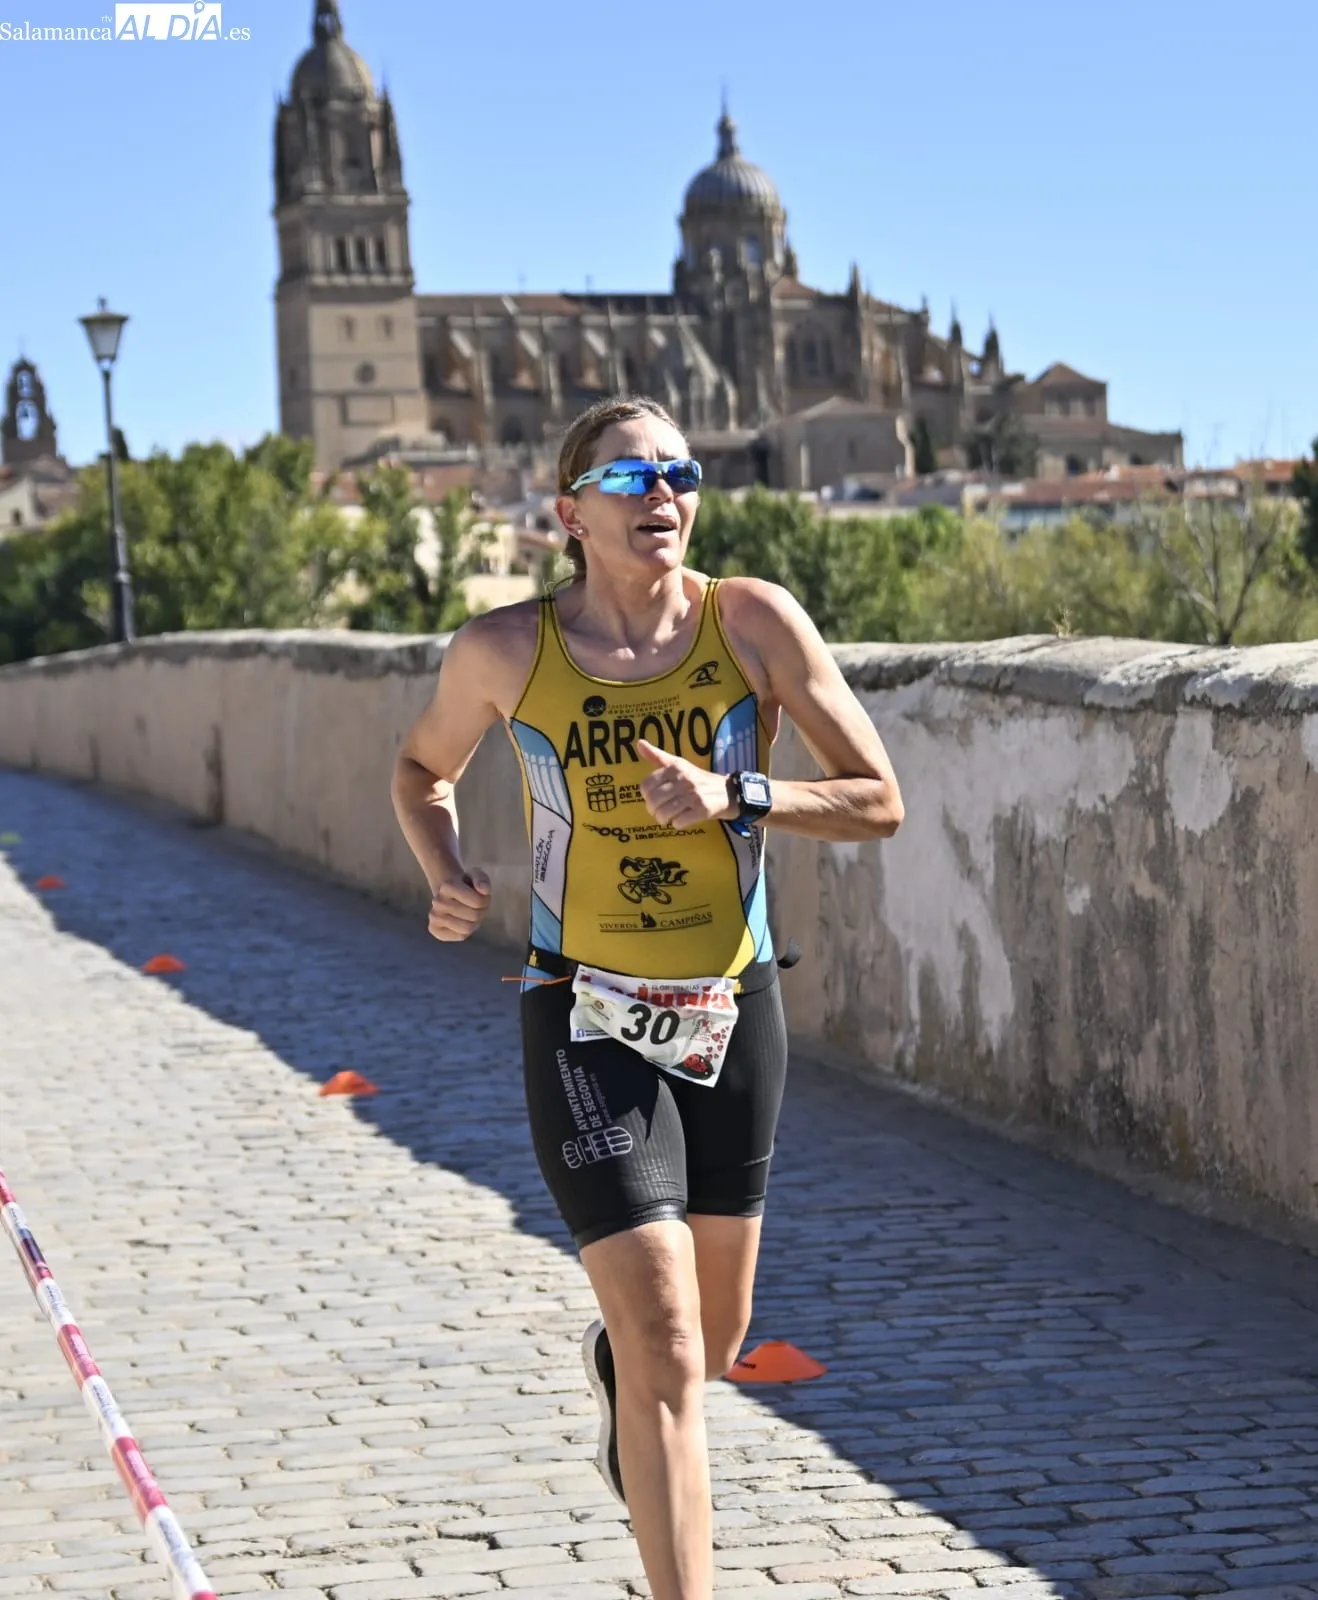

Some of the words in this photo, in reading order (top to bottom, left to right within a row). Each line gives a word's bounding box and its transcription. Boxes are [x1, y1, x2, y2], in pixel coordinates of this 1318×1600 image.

[564, 706, 713, 770] ARROYO
[620, 1003, 680, 1046] 30
[555, 1048, 590, 1131] AYUNTAMIENTO
[572, 1066, 597, 1113] SEGOVIA
[588, 1113, 603, 1129] DE
